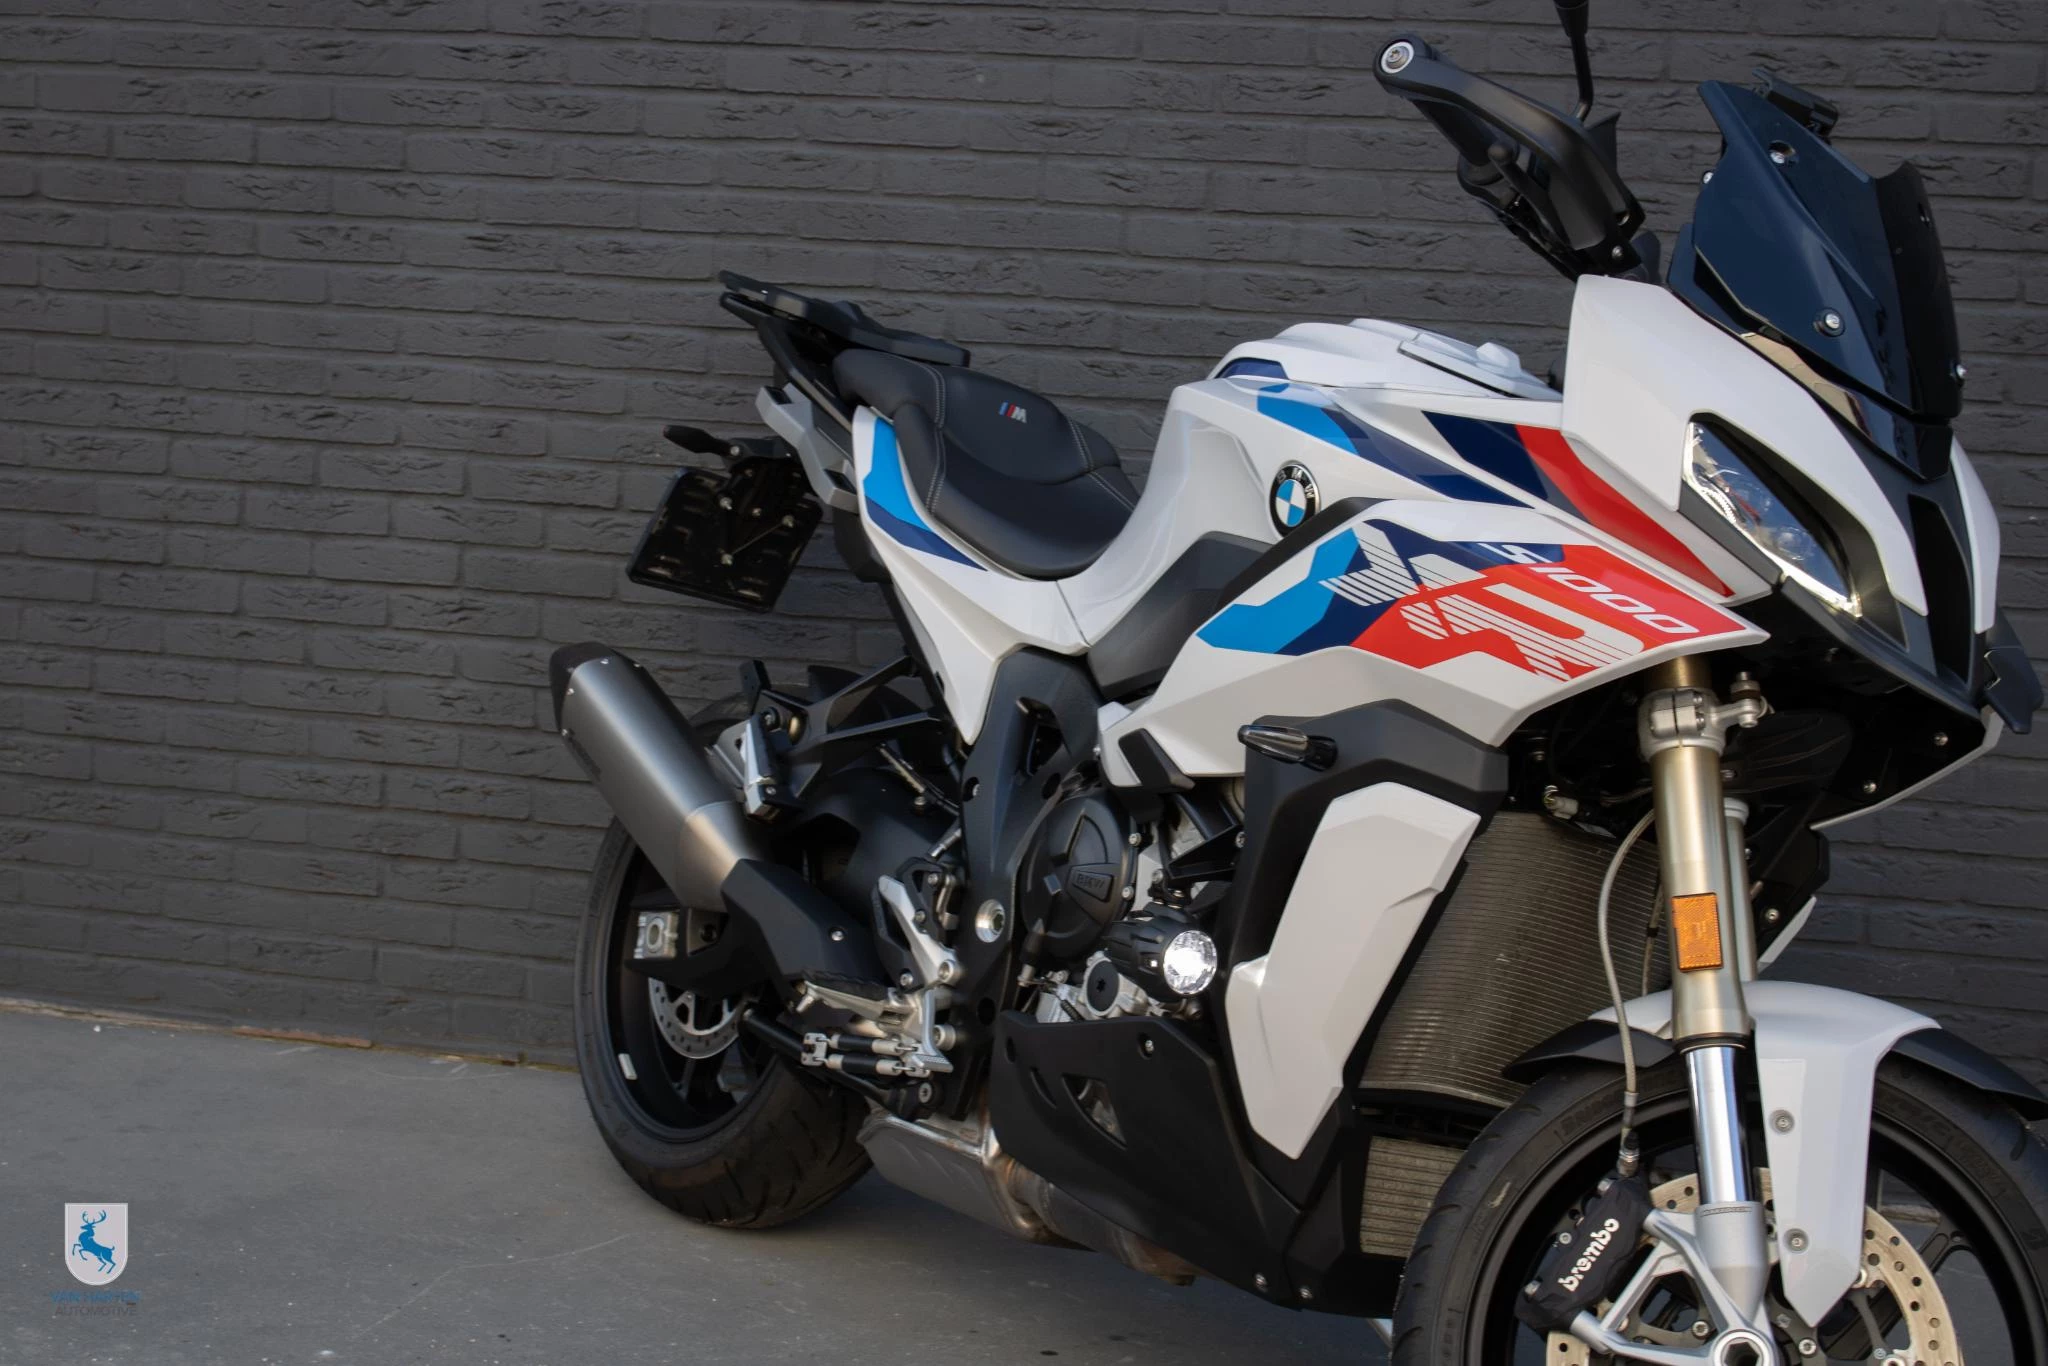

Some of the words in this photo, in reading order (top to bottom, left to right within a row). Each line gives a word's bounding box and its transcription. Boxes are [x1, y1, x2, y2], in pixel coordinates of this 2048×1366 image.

[1275, 466, 1316, 499] BMW
[1528, 566, 1701, 634] 1000
[1557, 1217, 1620, 1293] brembo
